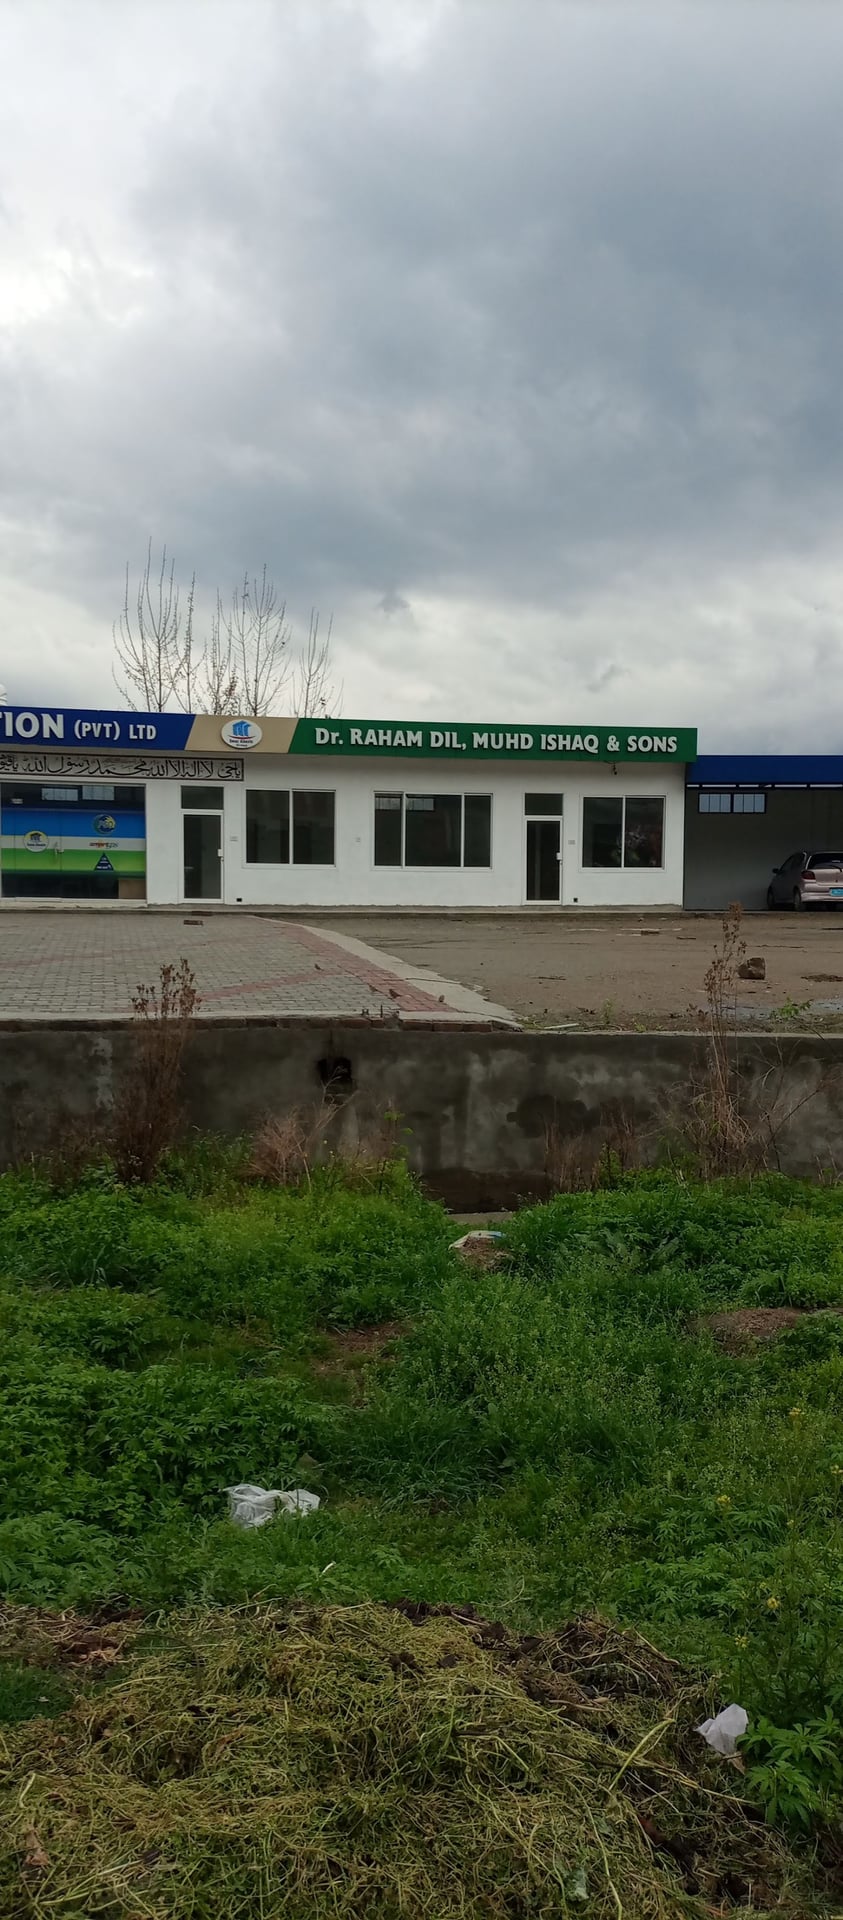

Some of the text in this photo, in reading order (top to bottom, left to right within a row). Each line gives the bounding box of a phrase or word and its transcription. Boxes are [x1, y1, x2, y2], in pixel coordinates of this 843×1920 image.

[0, 711, 157, 740] ION (PVT) LTD
[315, 728, 678, 753] Dr. RAHAM DIL, MUHD ISHAQ & SONS
